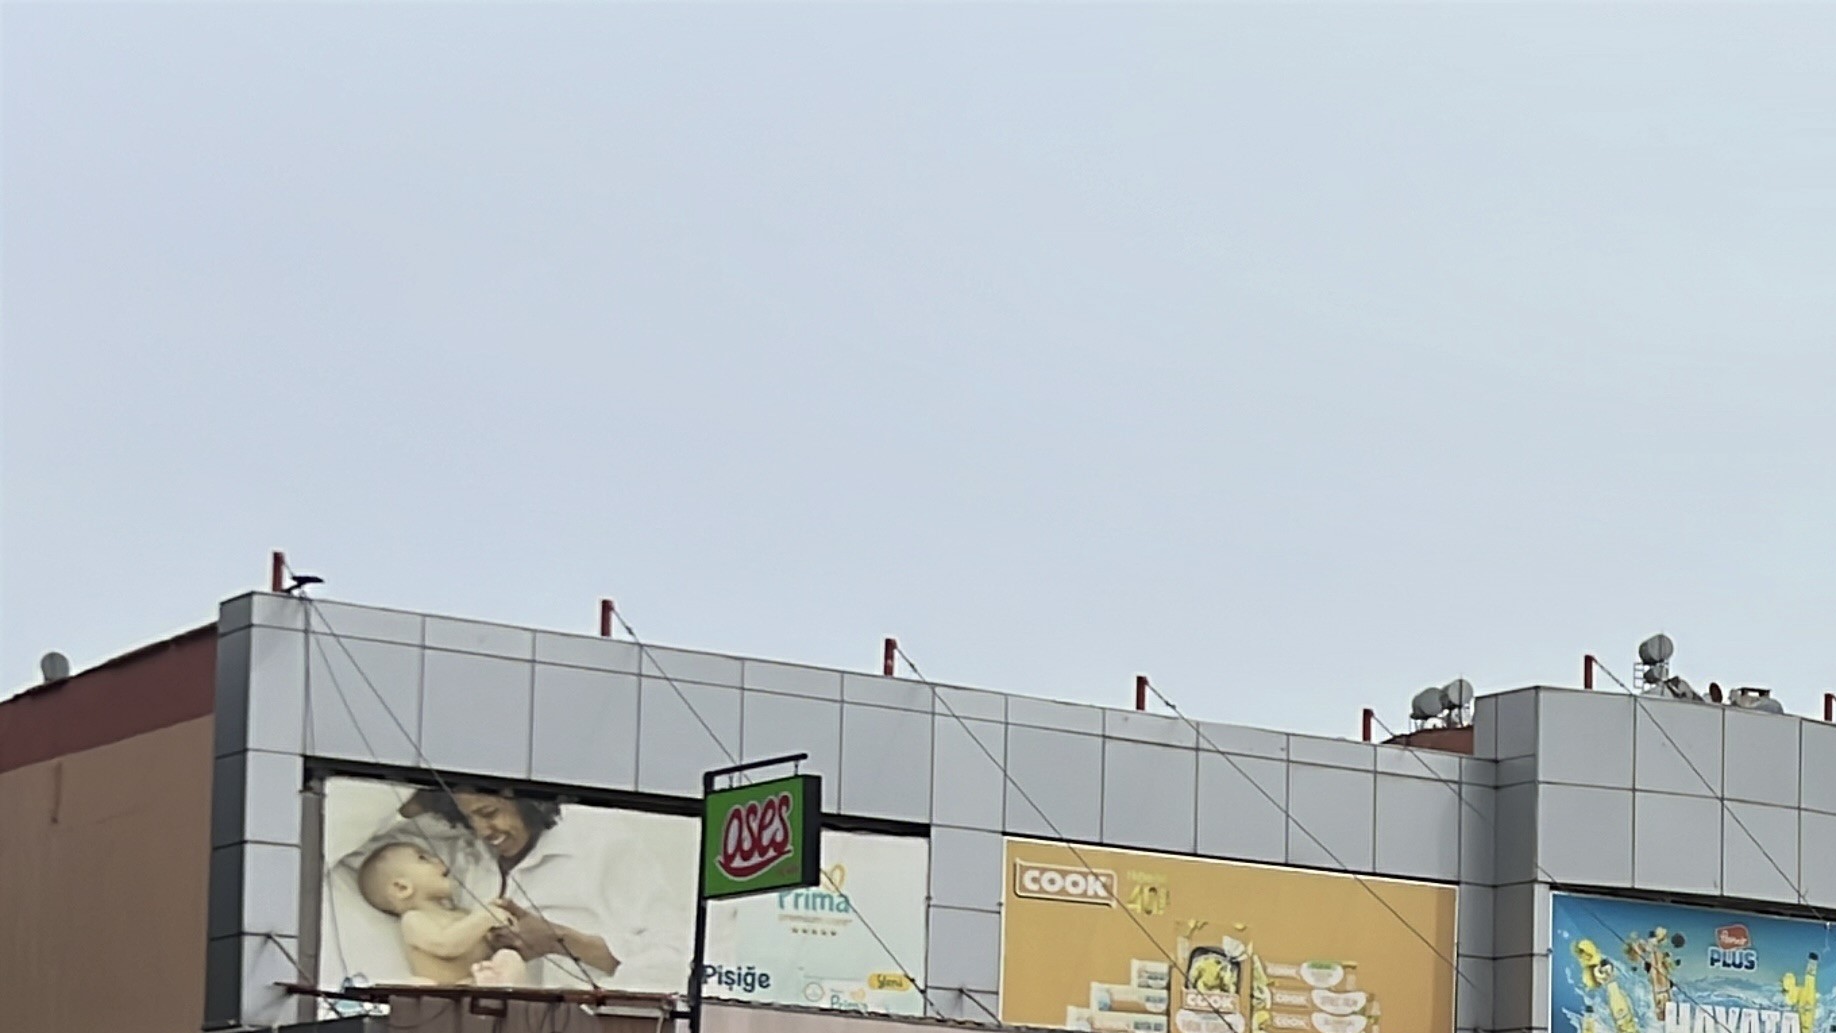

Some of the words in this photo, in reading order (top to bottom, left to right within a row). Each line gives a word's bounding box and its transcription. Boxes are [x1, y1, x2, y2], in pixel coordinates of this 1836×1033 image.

[1022, 873, 1107, 898] COOK
[1709, 949, 1756, 970] PLUS
[703, 963, 771, 993] Pişiğe
